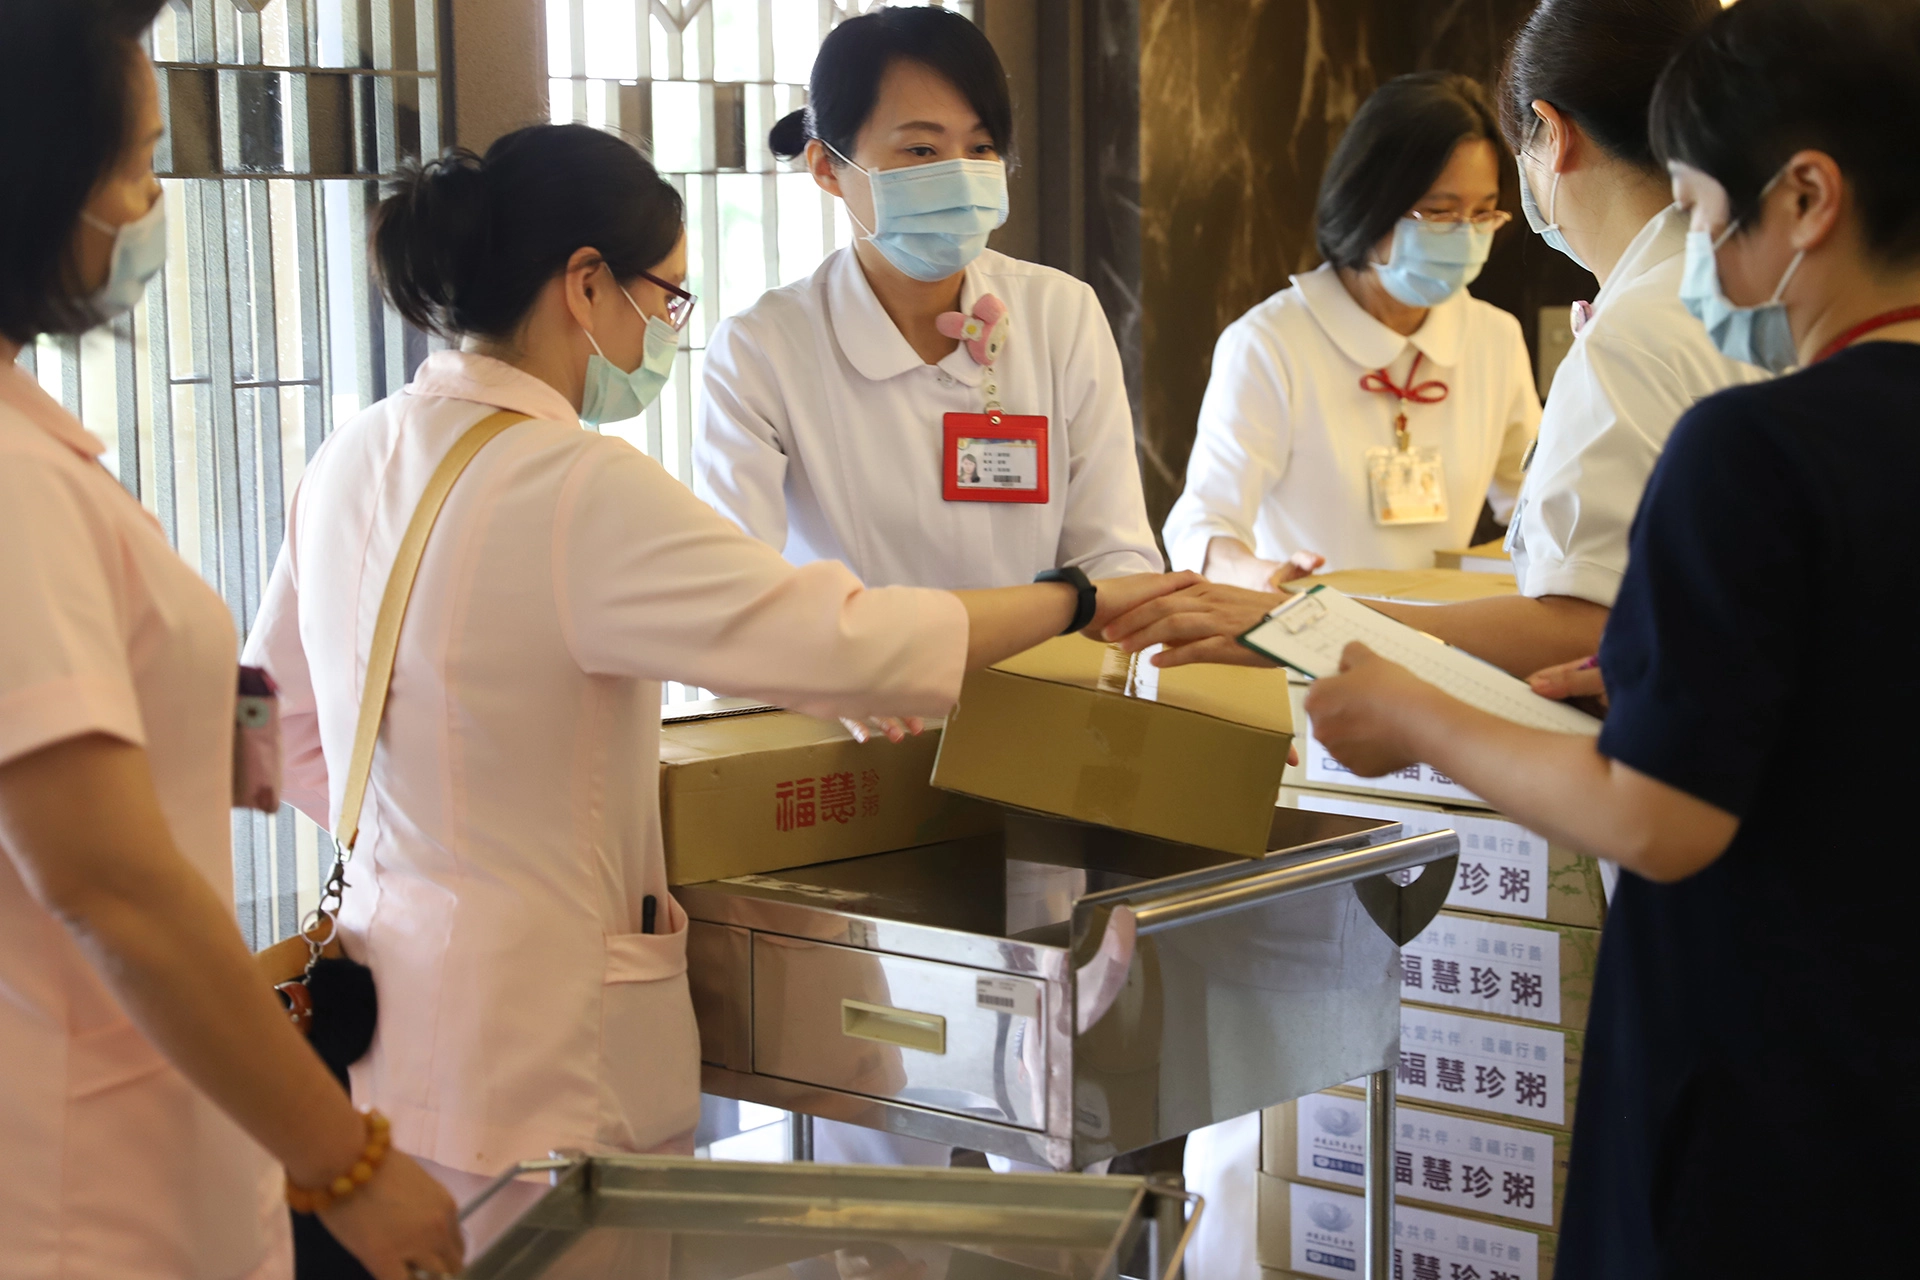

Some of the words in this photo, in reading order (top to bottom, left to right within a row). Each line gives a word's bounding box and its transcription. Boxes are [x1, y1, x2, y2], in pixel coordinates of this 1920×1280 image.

[1458, 861, 1531, 904] 珍粥
[1398, 1051, 1548, 1109] 福慧珍粥
